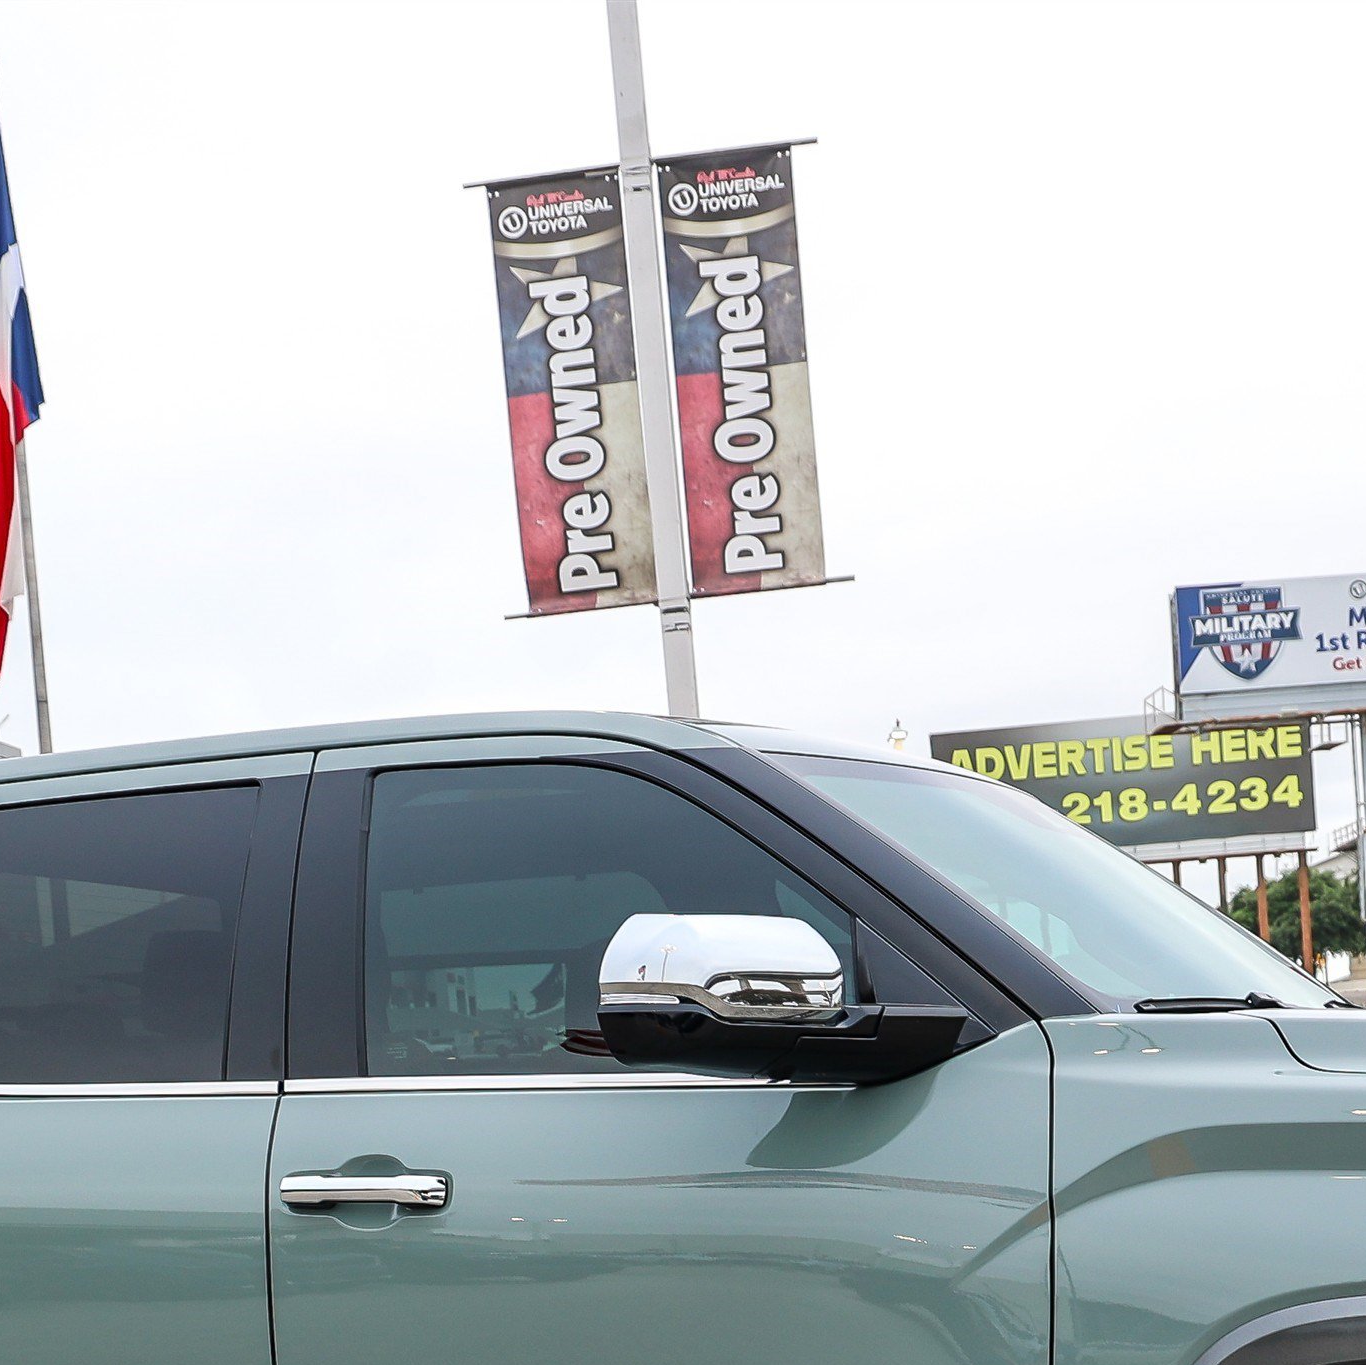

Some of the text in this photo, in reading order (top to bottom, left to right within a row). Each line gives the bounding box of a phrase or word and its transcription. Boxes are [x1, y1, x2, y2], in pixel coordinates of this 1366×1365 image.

[699, 173, 785, 197] UNIVERSAL
[528, 196, 613, 220] UNIVERSAL
[700, 193, 759, 213] TOYOTA
[529, 215, 587, 235] TOYOTA
[699, 254, 775, 464] Owned
[527, 274, 606, 482] Owned
[725, 474, 785, 575] Pre
[559, 492, 620, 594] Pre
[1195, 611, 1295, 636] MILITARY
[1315, 632, 1350, 652] 1st
[1333, 656, 1362, 671] Get
[950, 726, 1303, 781] ADVERTISE HERE
[1062, 775, 1304, 824] 218-4234
